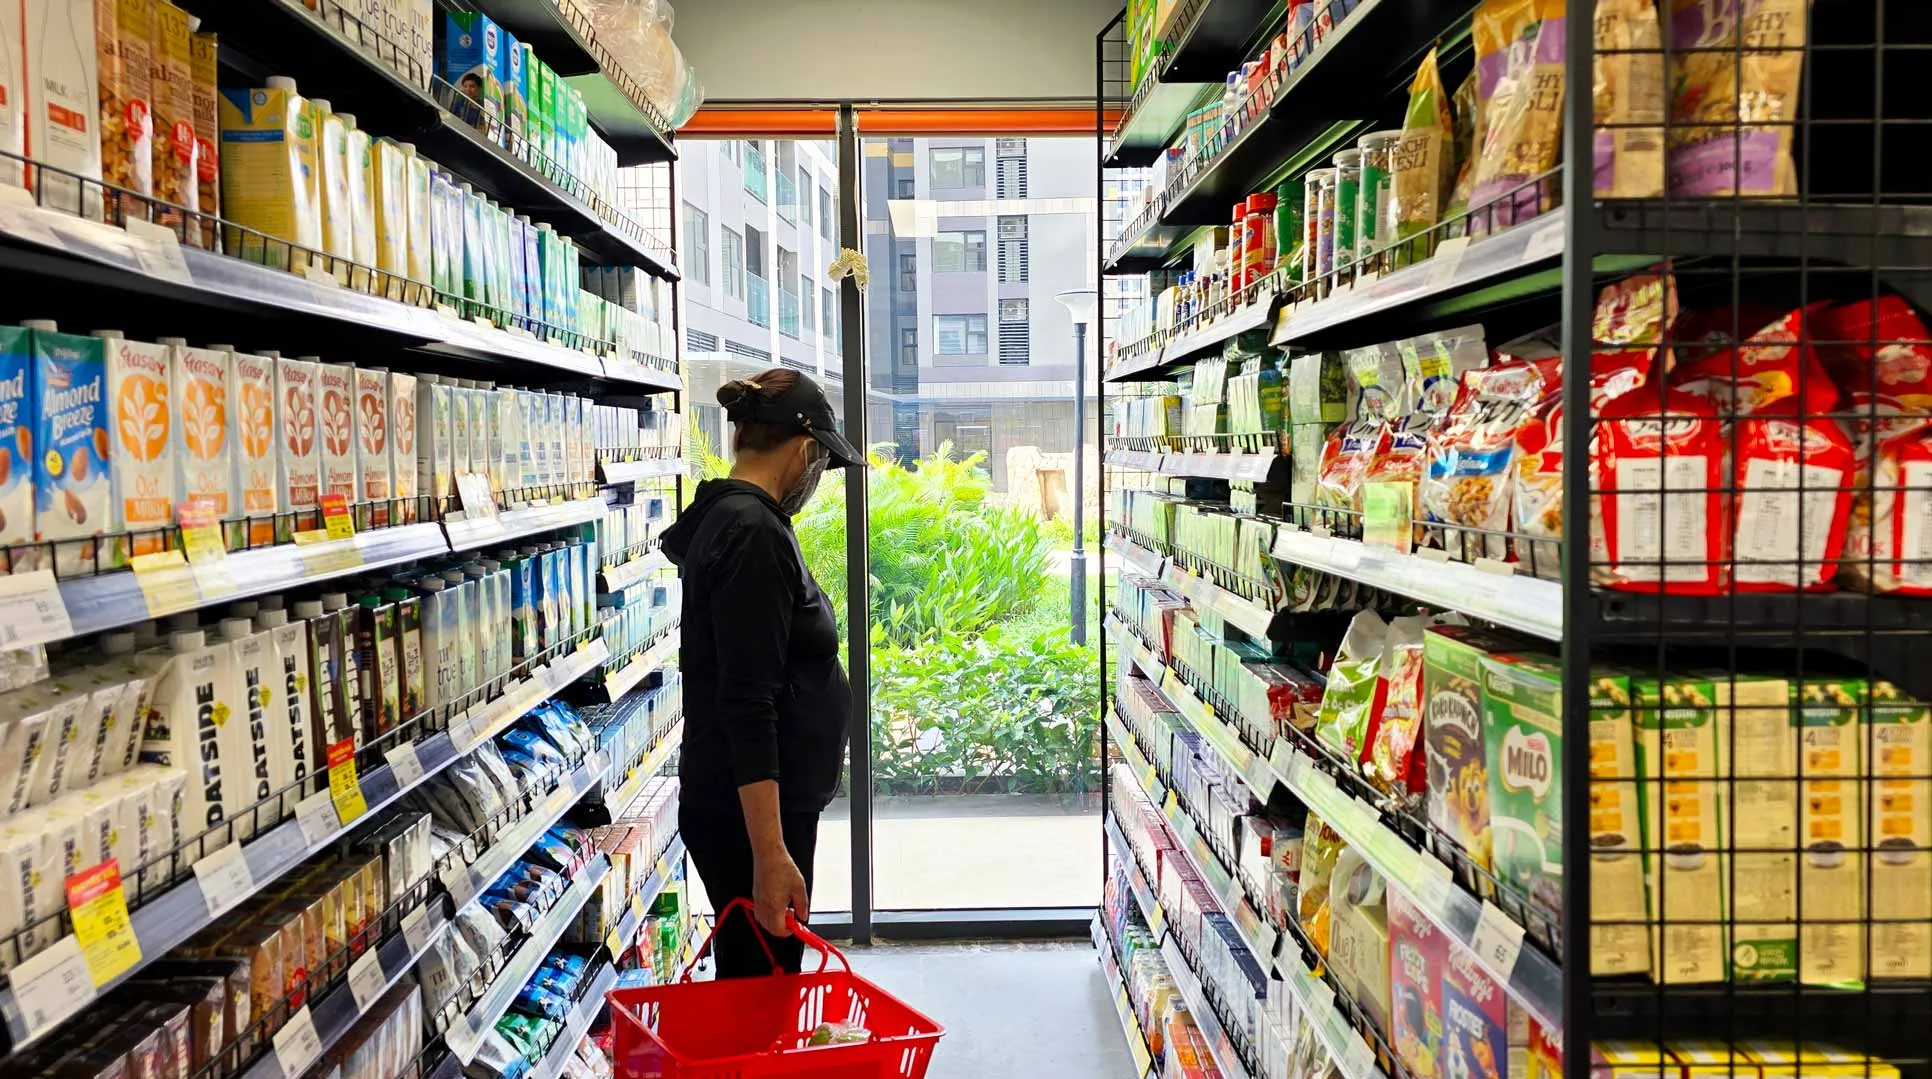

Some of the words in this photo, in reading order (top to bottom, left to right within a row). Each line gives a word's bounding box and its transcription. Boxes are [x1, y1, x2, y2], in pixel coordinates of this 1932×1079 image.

[43, 375, 100, 420] Almond
[53, 405, 95, 440] Breeze
[318, 643, 338, 746] ATSIDE
[1508, 744, 1547, 783] MILO
